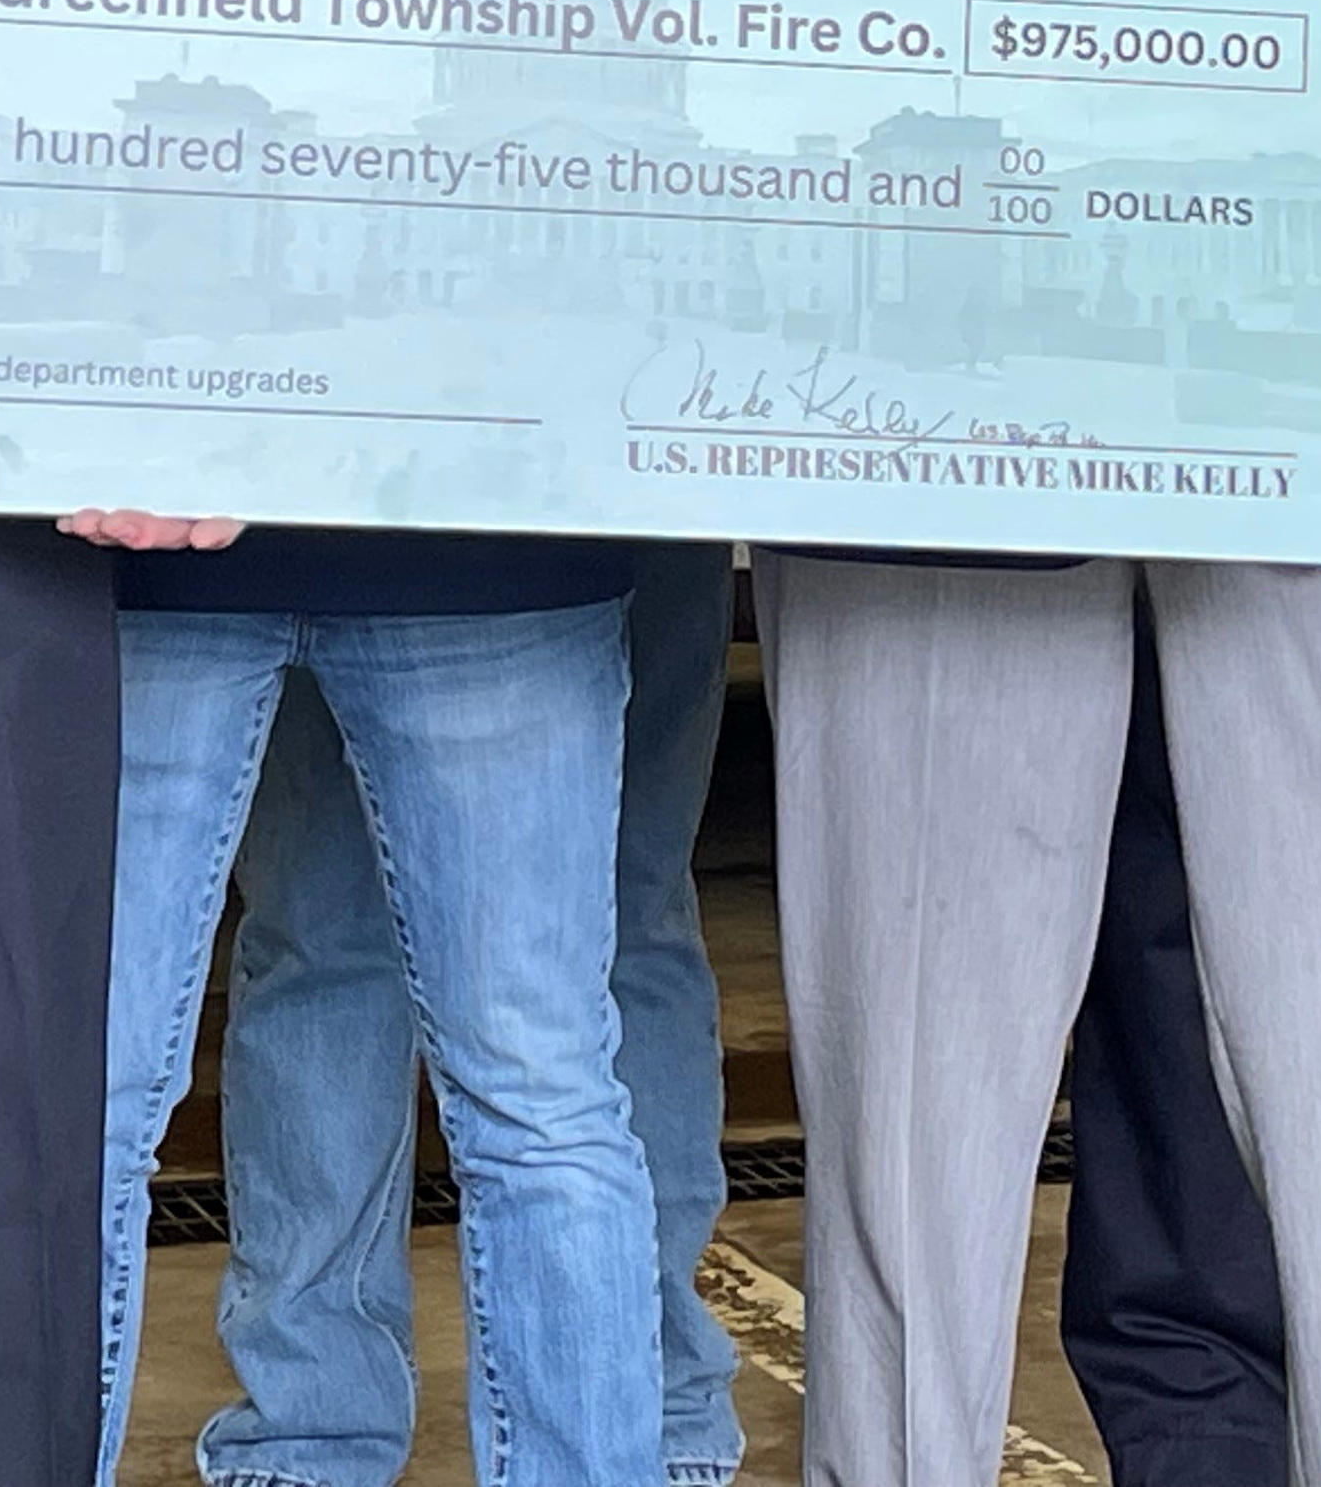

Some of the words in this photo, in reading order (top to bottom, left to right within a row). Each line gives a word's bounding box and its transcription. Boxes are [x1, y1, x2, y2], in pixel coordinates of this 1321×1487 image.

[737, 3, 841, 54] Fire
[857, 10, 947, 60] Co.
[991, 14, 1281, 71] $975,000.00
[14, 116, 244, 174] hundred
[260, 139, 590, 196] seventy-five
[606, 147, 852, 204] thousand
[867, 163, 962, 210] and
[999, 145, 1046, 176] 00
[987, 195, 1053, 226] 100
[1086, 190, 1254, 227] DOLLARS
[187, 366, 330, 398] upgrades
[627, 439, 699, 476] U.S.
[706, 443, 1059, 490] REPRESENTATIVE
[1067, 457, 1166, 495] MIKE
[1172, 460, 1297, 499] KELLY
